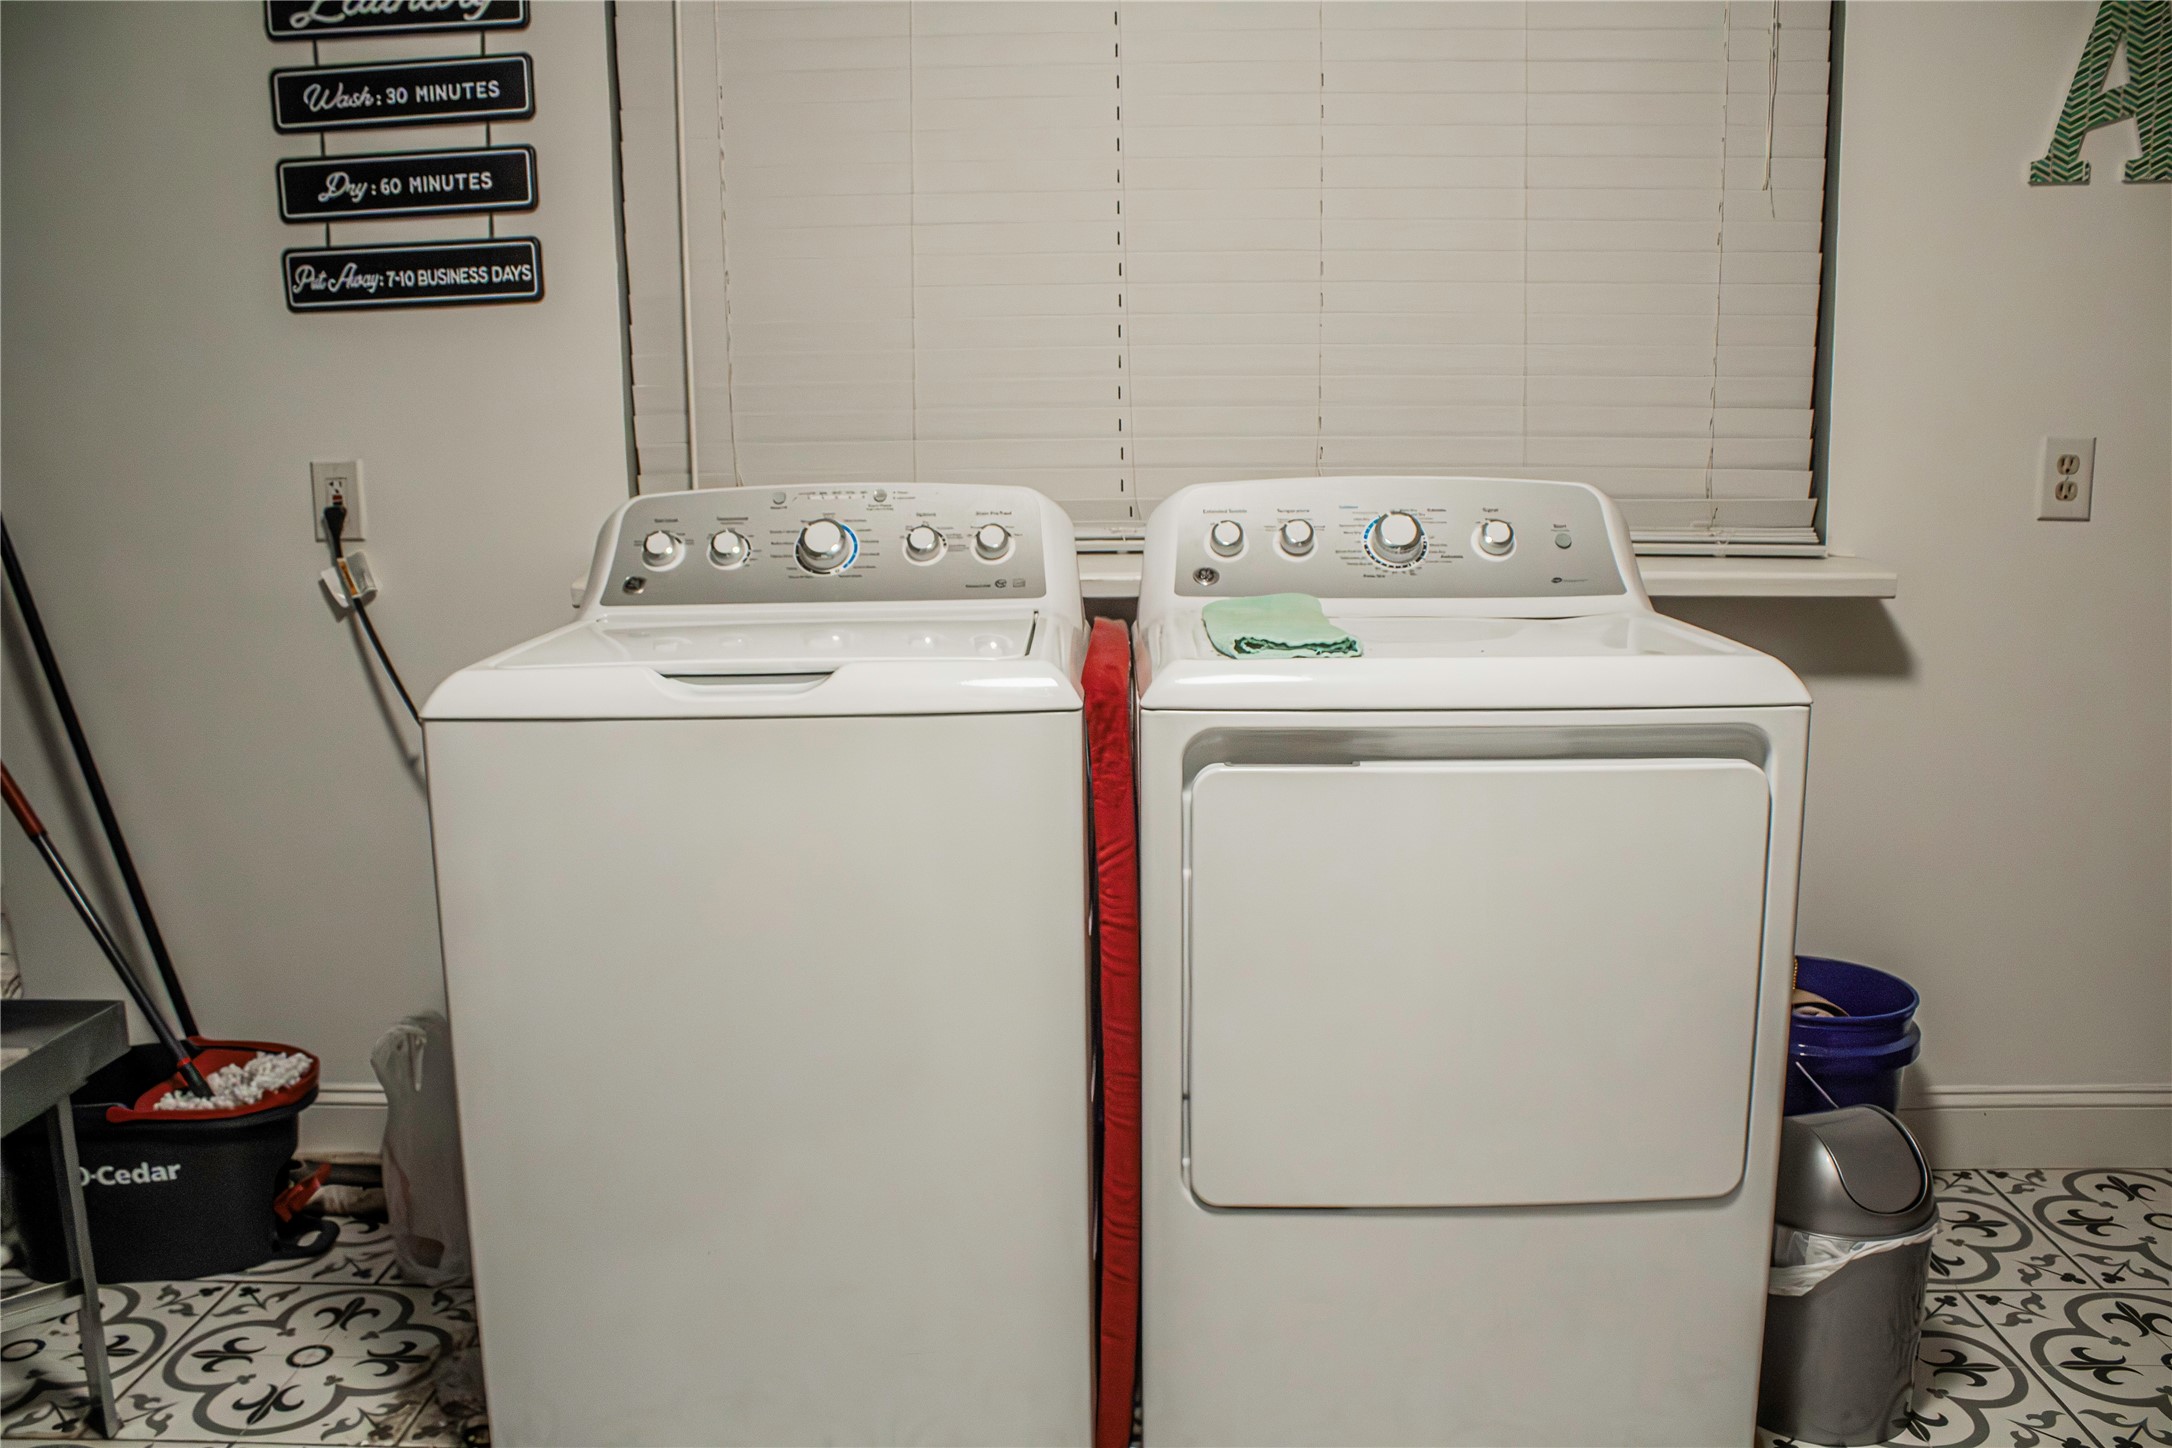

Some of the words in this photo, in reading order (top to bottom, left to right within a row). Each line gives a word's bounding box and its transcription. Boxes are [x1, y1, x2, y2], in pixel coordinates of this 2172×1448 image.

[386, 87, 408, 104] 30
[416, 80, 500, 103] MINUTES
[2029, 0, 2172, 184] A
[380, 177, 402, 195] 60
[409, 172, 493, 194] MINUTES
[292, 264, 327, 294] Put
[327, 262, 384, 293] Away:
[387, 271, 414, 287] 7-10
[418, 265, 488, 286] BUSINESS
[492, 264, 532, 282] DAYS
